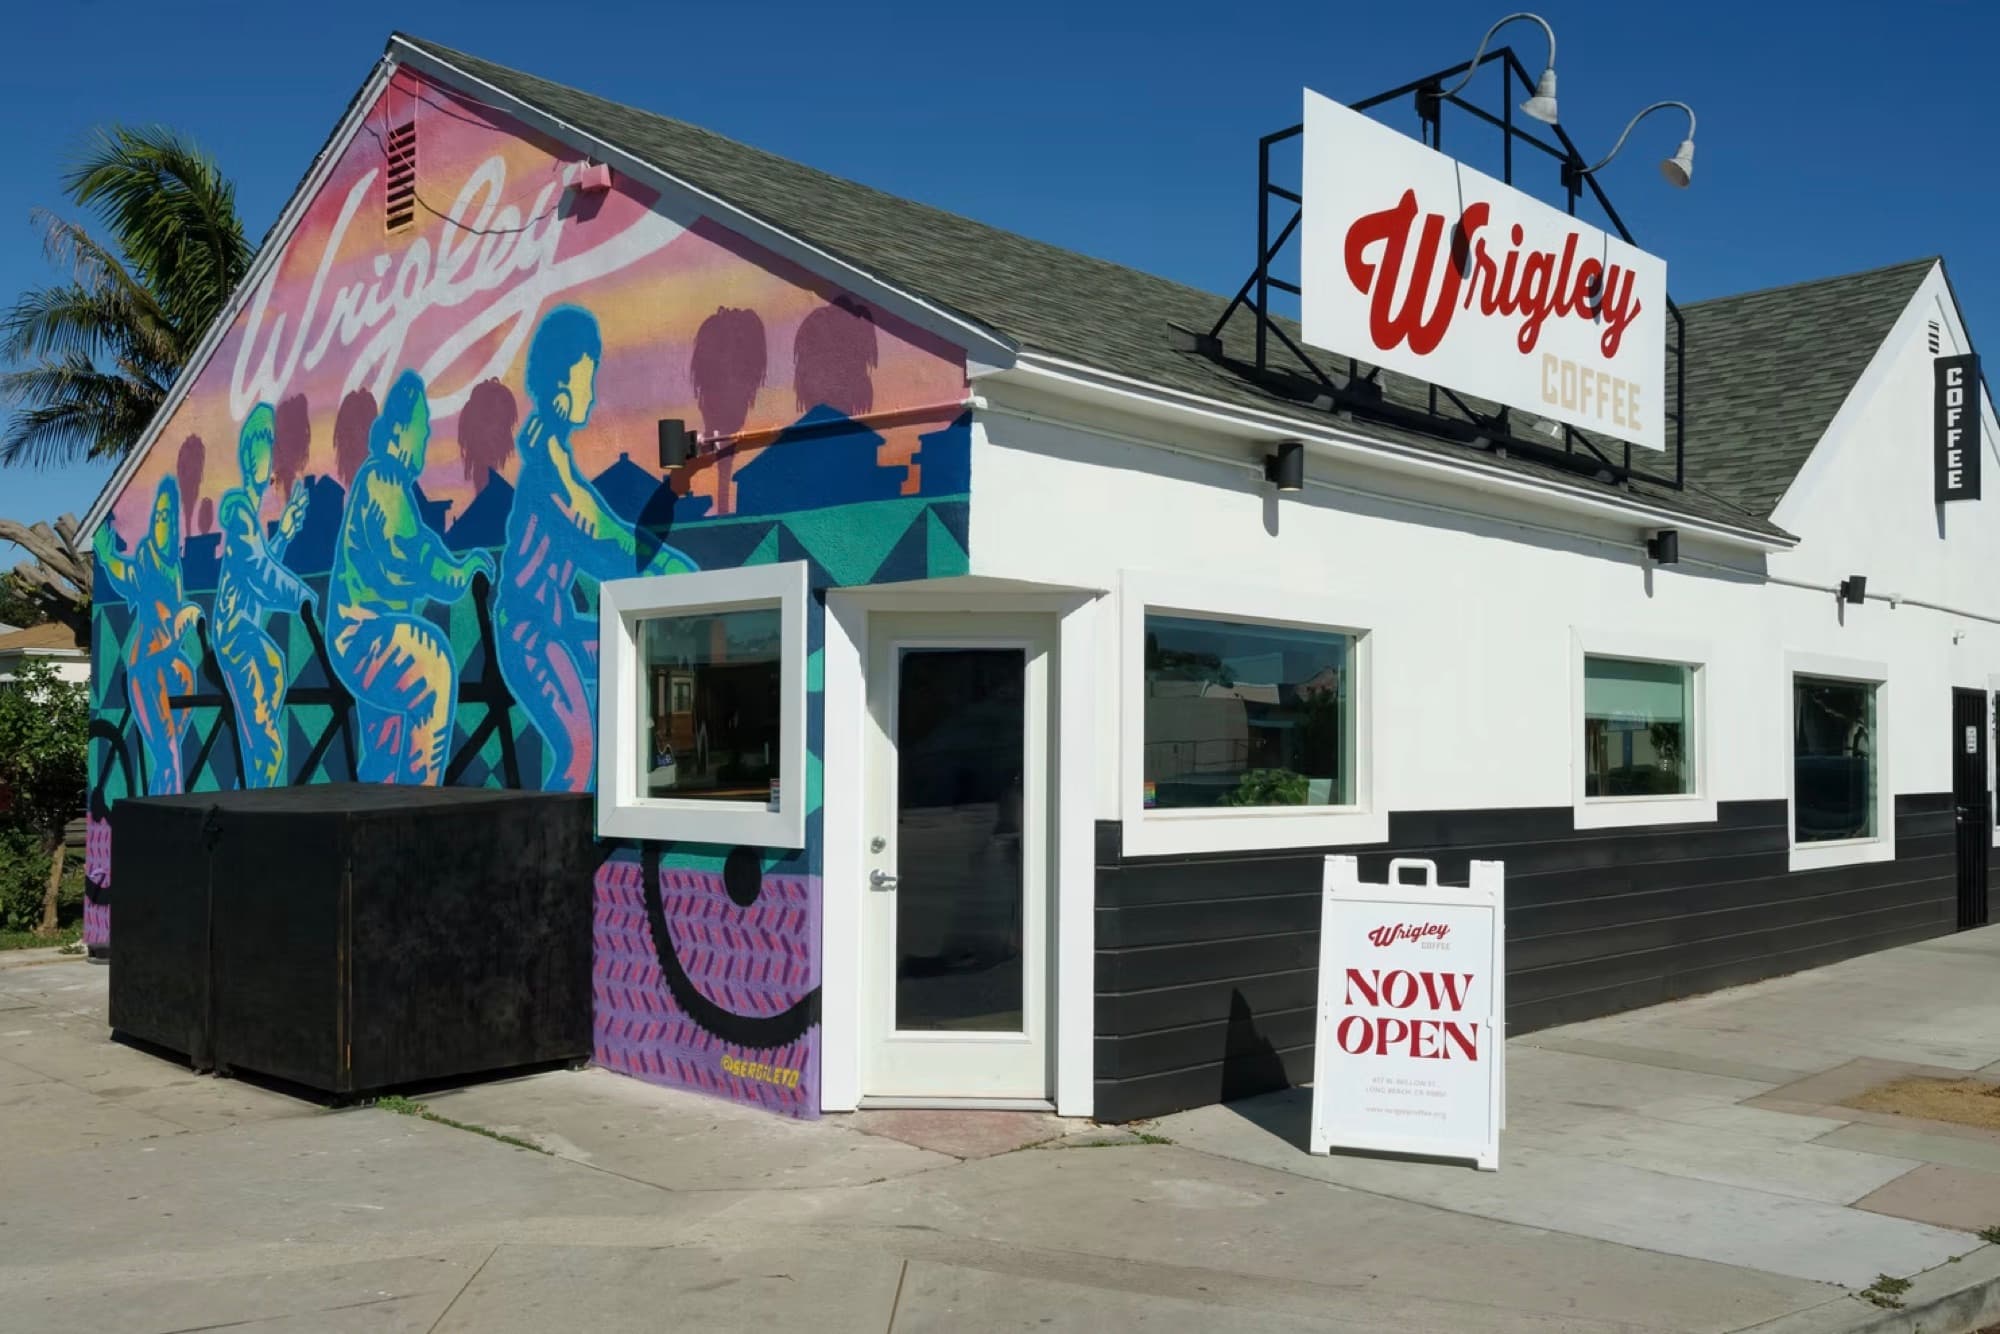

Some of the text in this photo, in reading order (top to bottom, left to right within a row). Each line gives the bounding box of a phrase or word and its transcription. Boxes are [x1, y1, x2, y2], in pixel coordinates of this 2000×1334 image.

[231, 155, 694, 422] Wrigley
[1344, 188, 1642, 359] Wrigley
[1541, 352, 1643, 431] COFFEE
[1946, 367, 1963, 489] COFFEE
[1368, 922, 1450, 947] Wrigley
[1345, 968, 1473, 1012] NOW
[1337, 1015, 1479, 1061] OPEN
